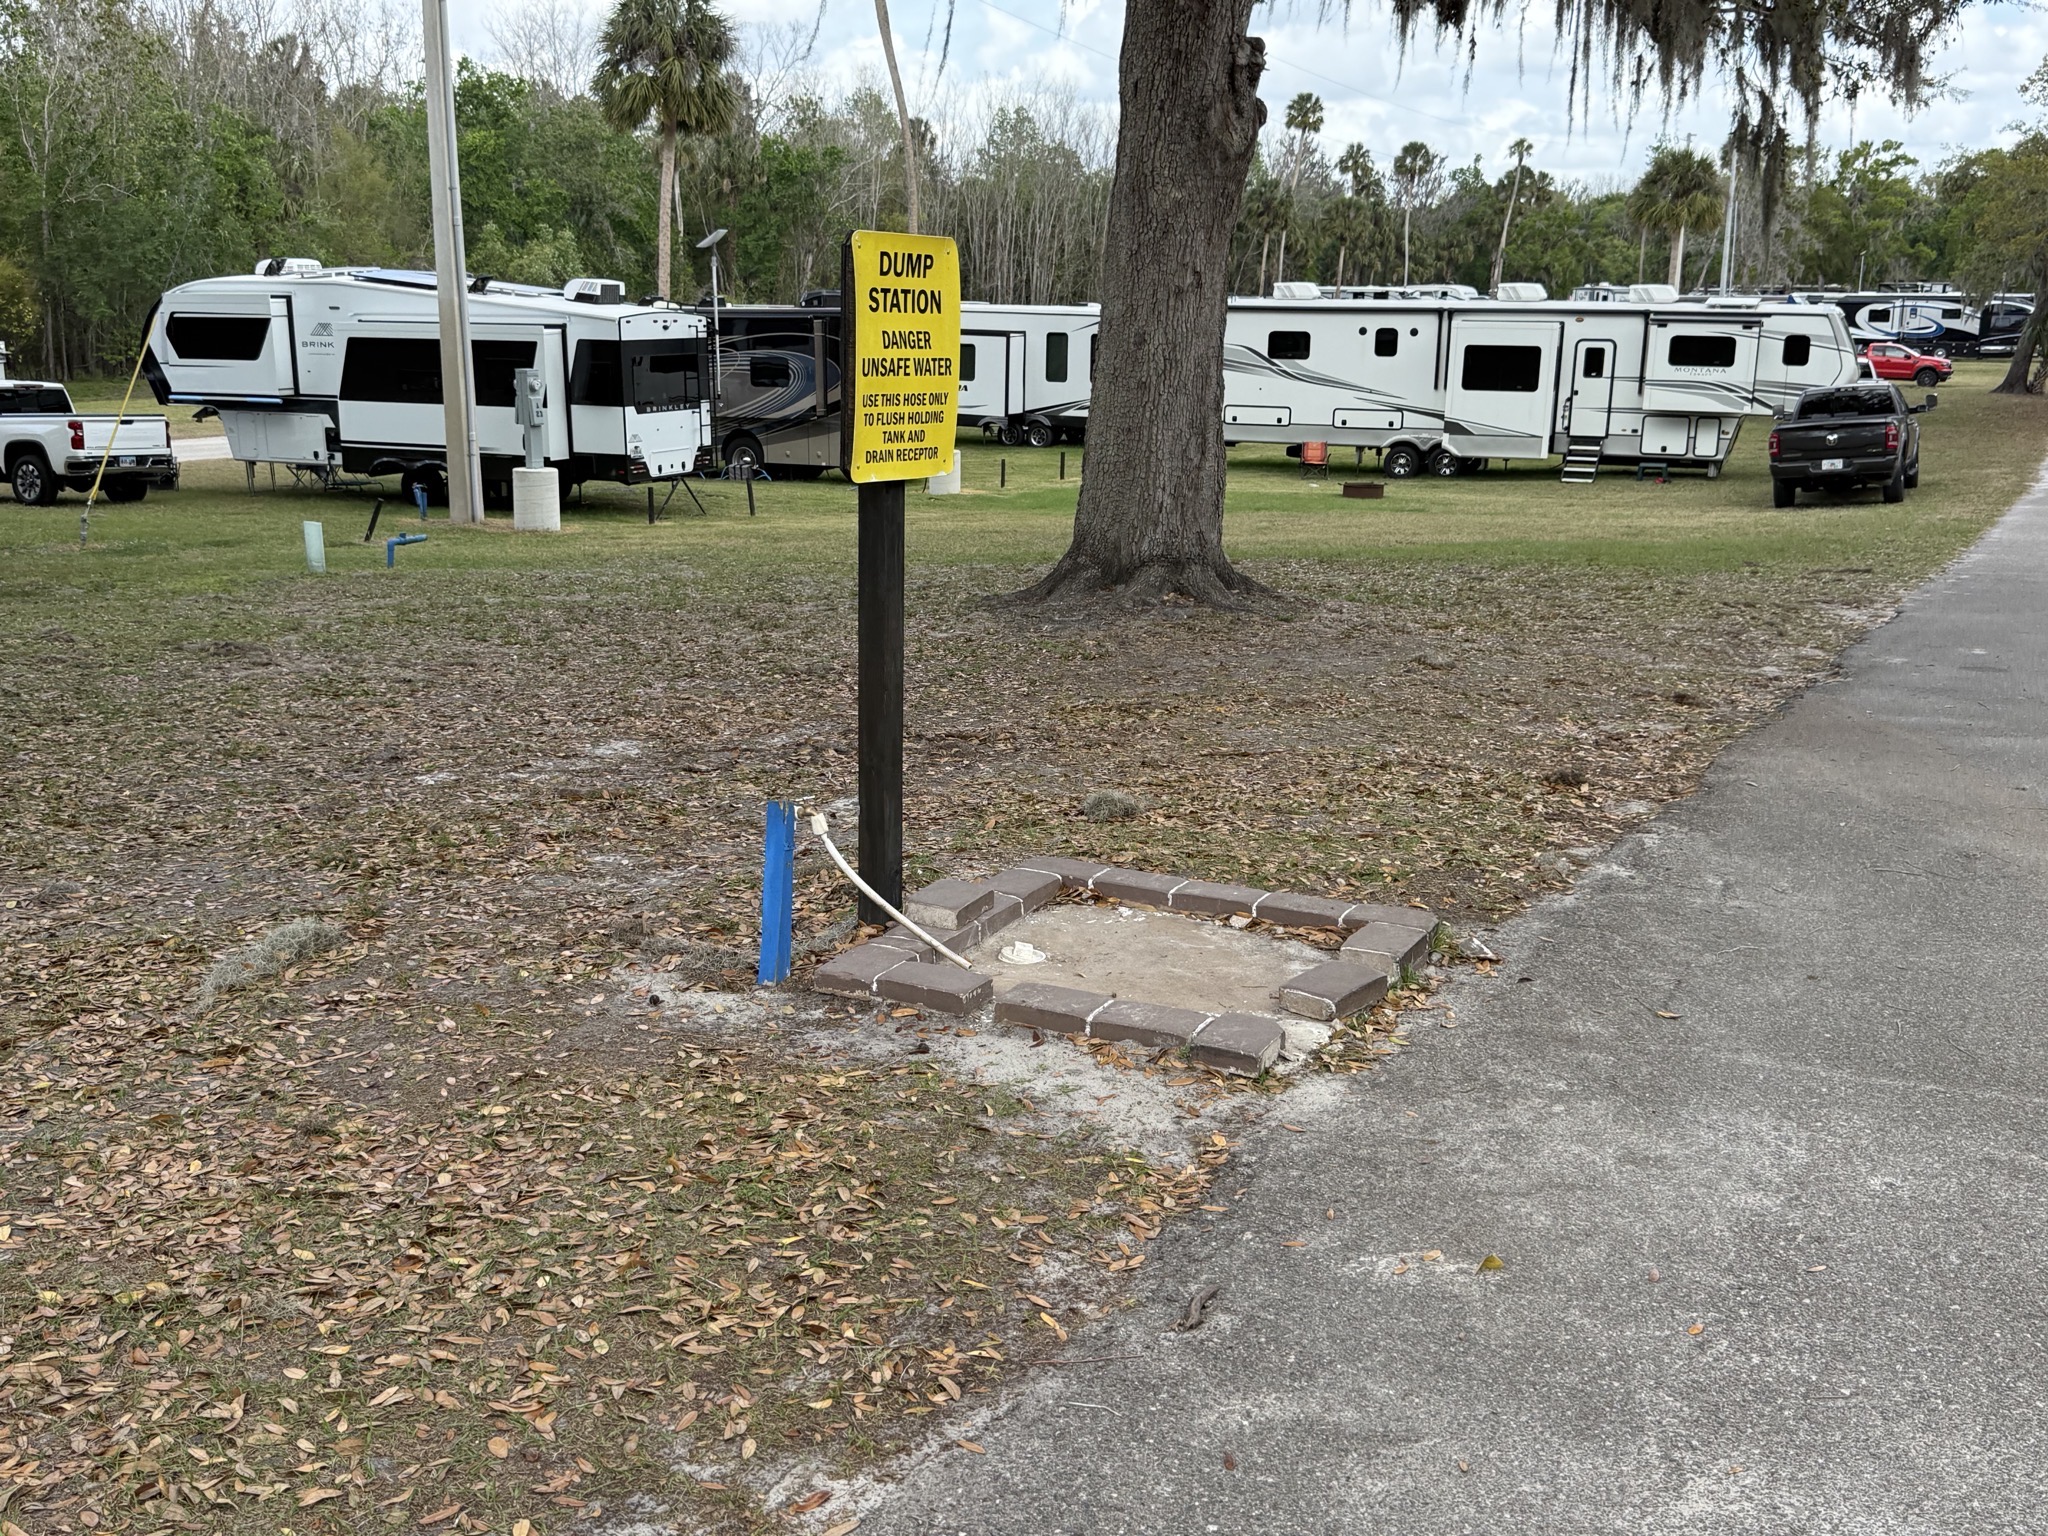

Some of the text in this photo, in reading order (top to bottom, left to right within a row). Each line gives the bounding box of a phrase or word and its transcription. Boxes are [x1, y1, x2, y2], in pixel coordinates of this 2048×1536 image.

[879, 251, 934, 279] DUMP
[868, 287, 942, 315] STATION
[882, 330, 932, 350] DANGER
[862, 357, 952, 377] UNSAFE WATER
[646, 404, 691, 413] BRINKLEY
[862, 392, 949, 408] USE THIS HOSE ONLY
[863, 410, 944, 427] TO FLUSH HOLDING
[882, 429, 926, 444] TANK AND
[865, 446, 939, 464] DRAIN RECEPTOR
